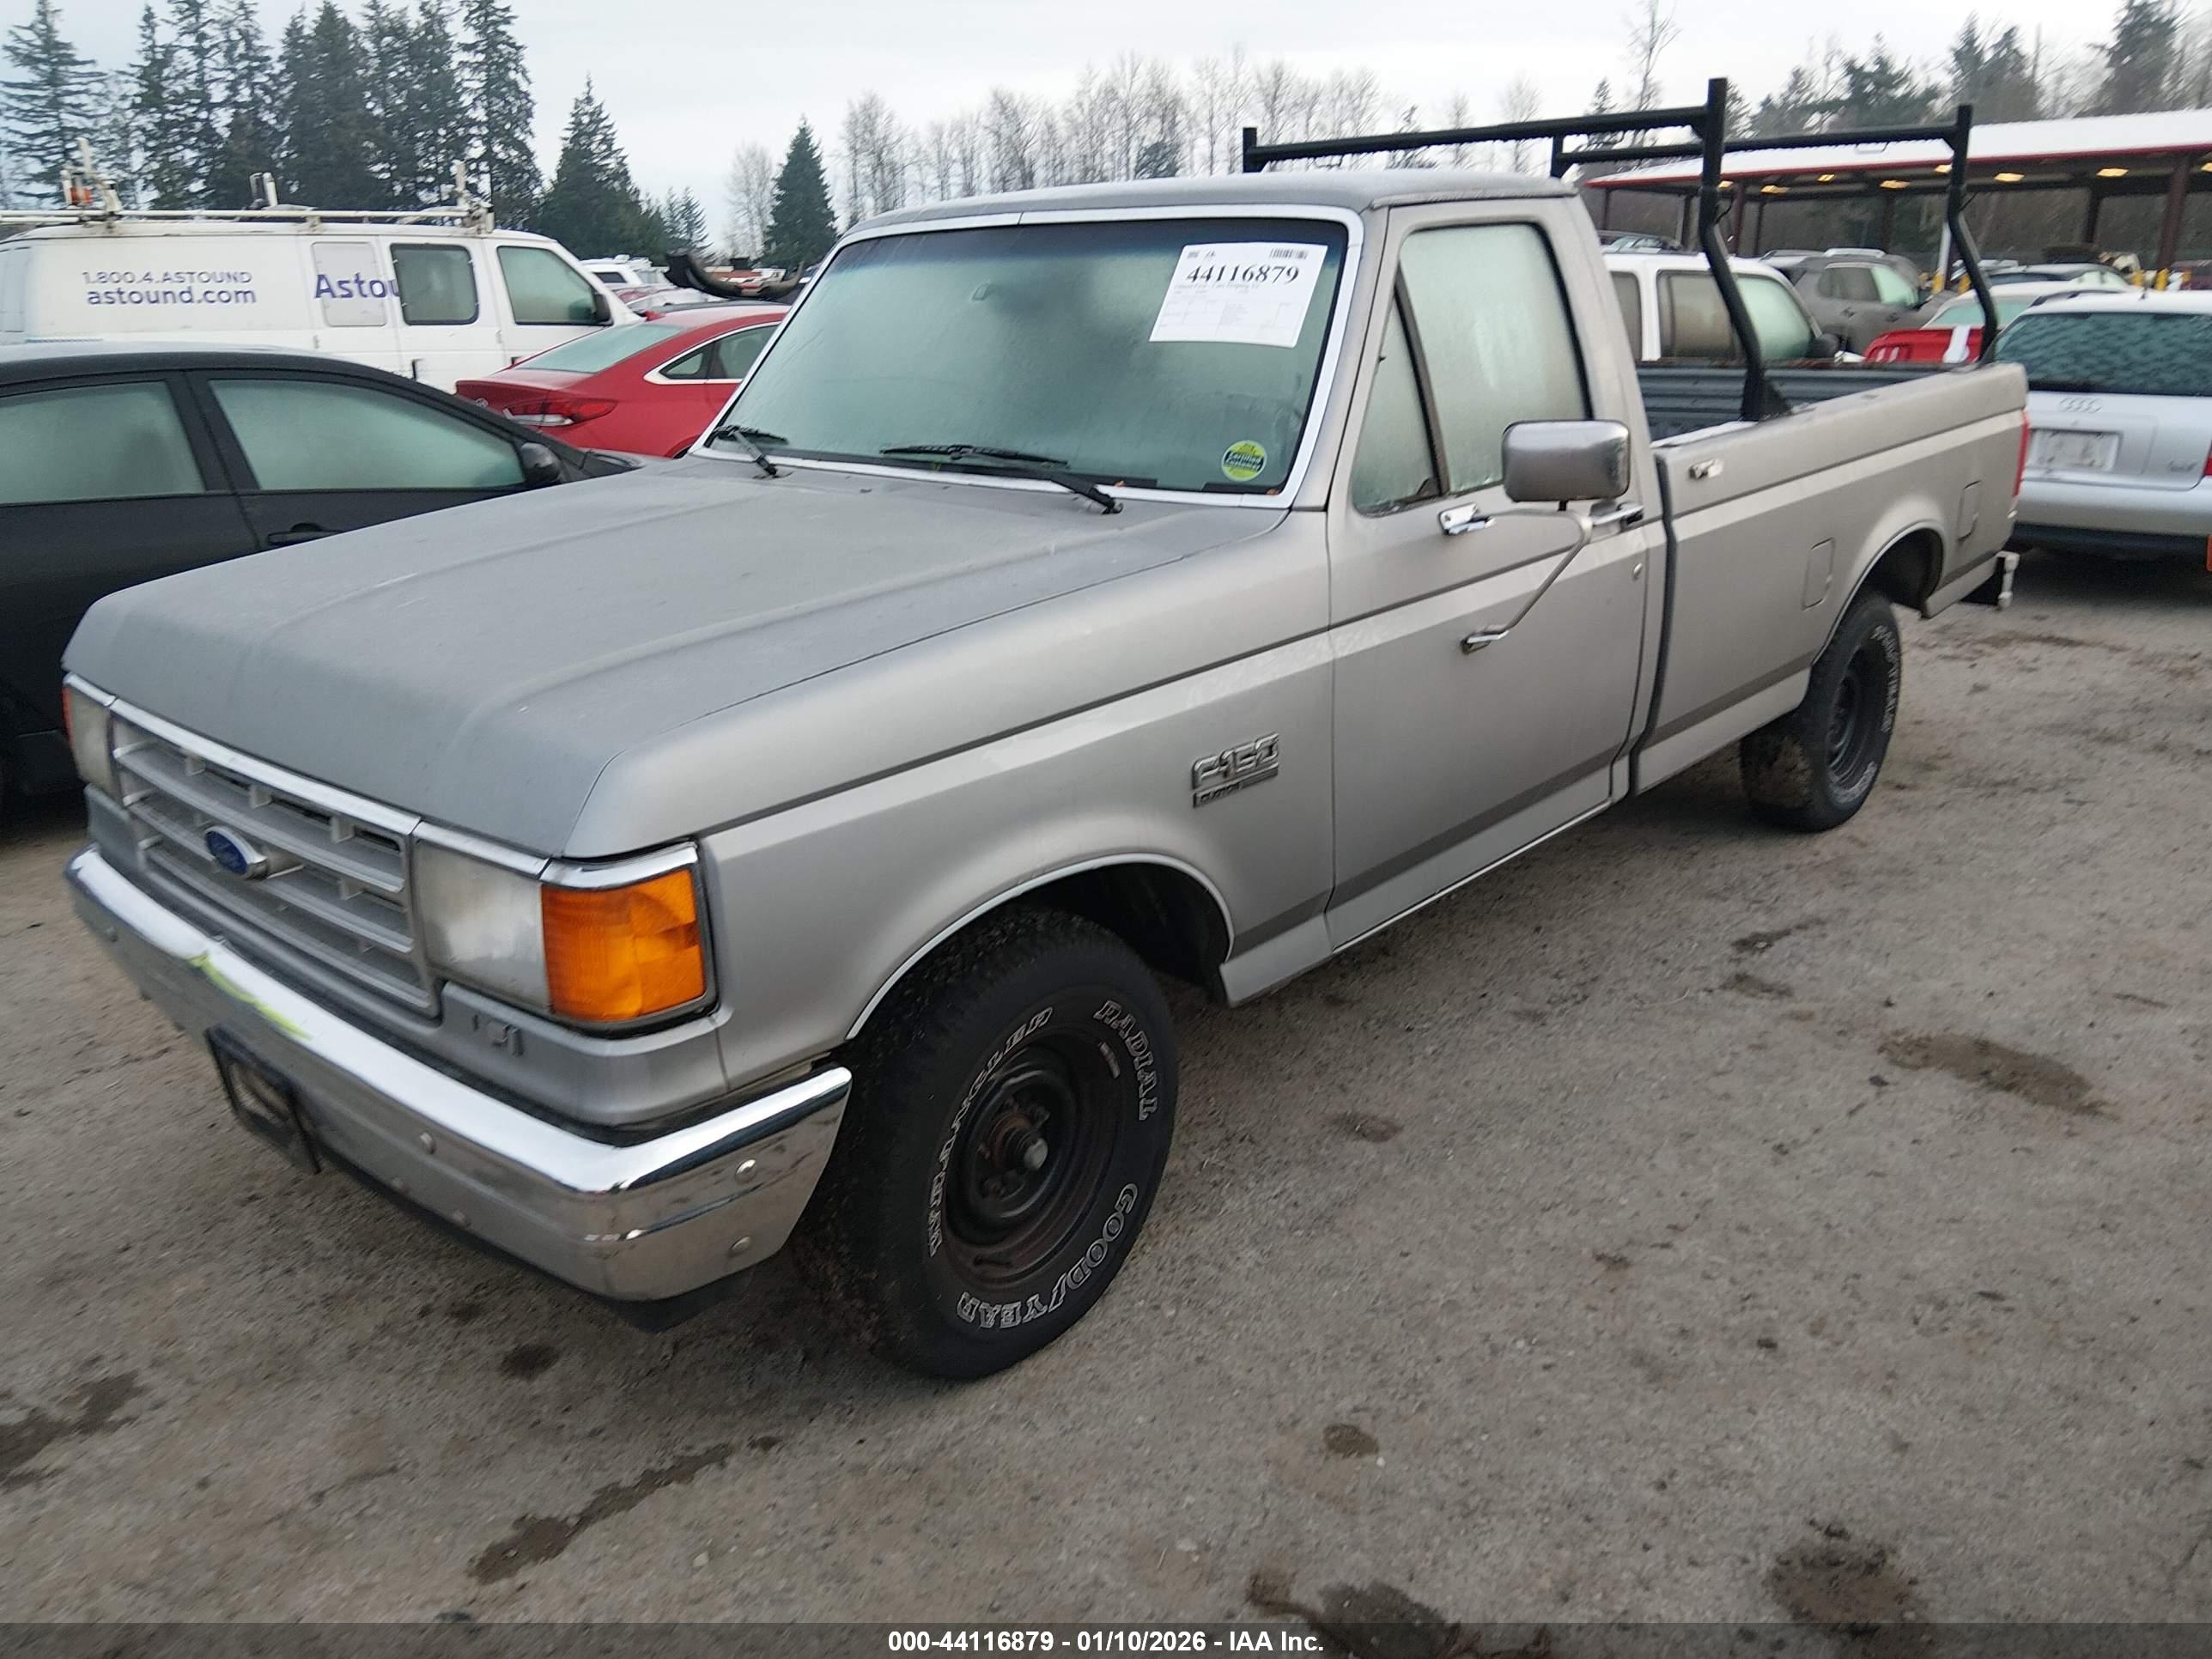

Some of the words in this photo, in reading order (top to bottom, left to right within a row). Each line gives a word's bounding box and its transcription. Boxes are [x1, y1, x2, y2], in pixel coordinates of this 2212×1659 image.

[82, 271, 252, 284] 1.800.4.ASTOUND
[1186, 264, 1299, 284] 44116879
[87, 287, 257, 305] astound.com
[1092, 1000, 1158, 1121] RADIAL
[927, 1007, 1053, 1257] WRANGLER
